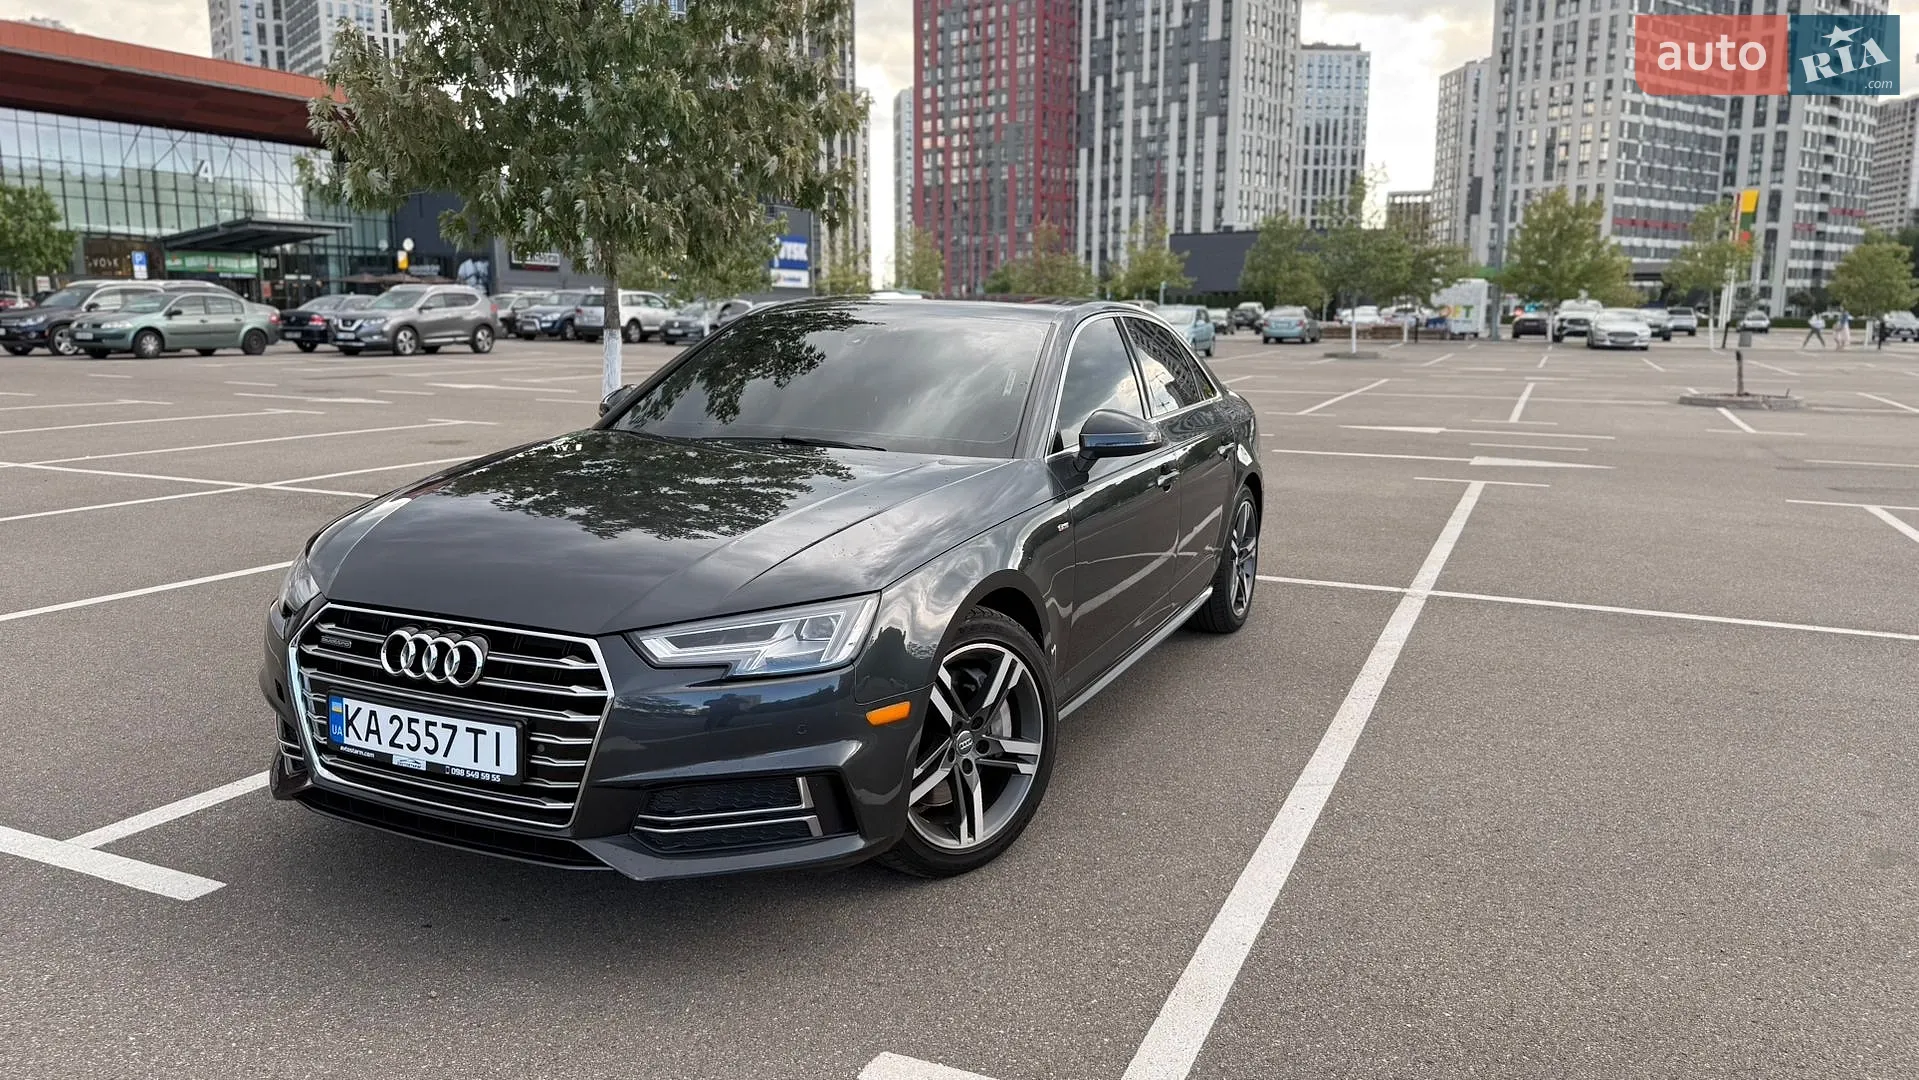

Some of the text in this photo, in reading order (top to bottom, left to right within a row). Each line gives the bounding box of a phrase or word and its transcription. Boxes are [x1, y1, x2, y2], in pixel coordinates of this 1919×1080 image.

[332, 724, 343, 736] UA
[345, 704, 500, 767] KA 2557 TI
